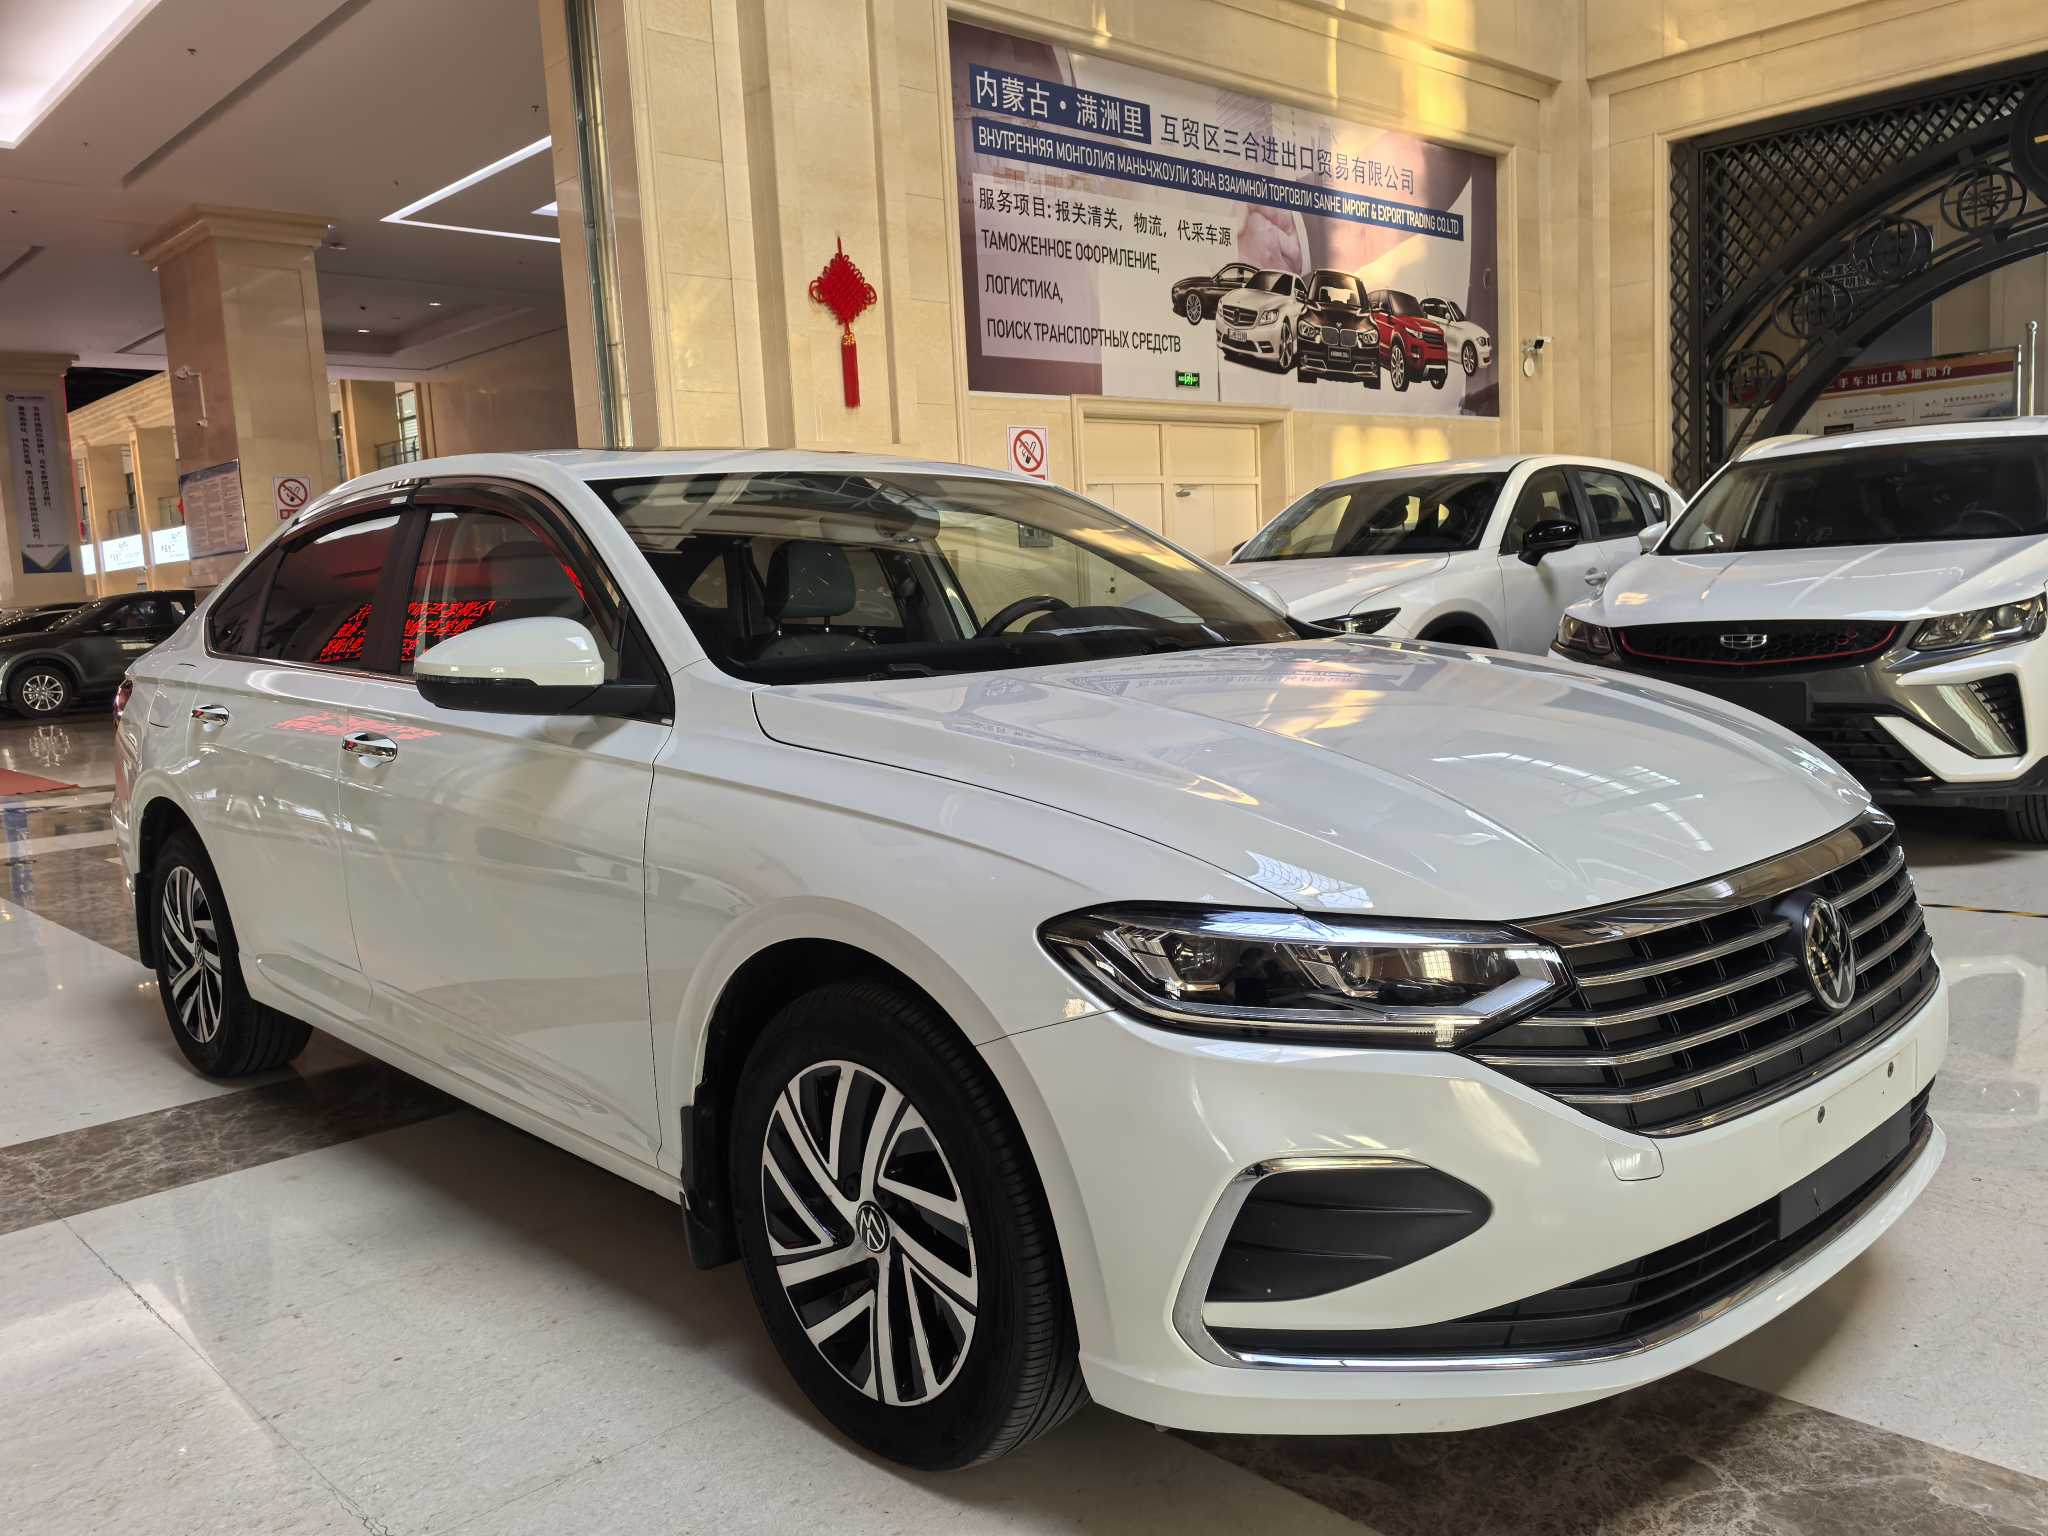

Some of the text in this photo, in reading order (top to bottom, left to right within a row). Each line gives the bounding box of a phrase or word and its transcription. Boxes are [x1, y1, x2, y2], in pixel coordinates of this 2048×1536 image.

[978, 125, 1054, 159] ВНУТРЕННЯЯ
[1056, 142, 1115, 171] МОНГОЛИЯ
[1117, 155, 1190, 185] МАНЬЧЖОУЛИ
[1191, 168, 1216, 191] ЗОНА
[1218, 173, 1268, 200] ВЗАИМНОЙ
[1268, 182, 1313, 207] ТОРГОВЛИ
[1314, 192, 1342, 214] SANHE
[1342, 197, 1370, 218] IMPORT
[1371, 203, 1377, 220] &
[1160, 113, 1415, 195] 互贸区三合进出口贸易有限公司
[981, 229, 1160, 274] ТАМОЖЕННОЕ ОФОРМЛЕНИЕ,
[985, 274, 1063, 304] ЛОГИСТИКА,
[987, 318, 1182, 355] ПОИСК ТРАНСПОРТНЫХ СРЕДСТВ
